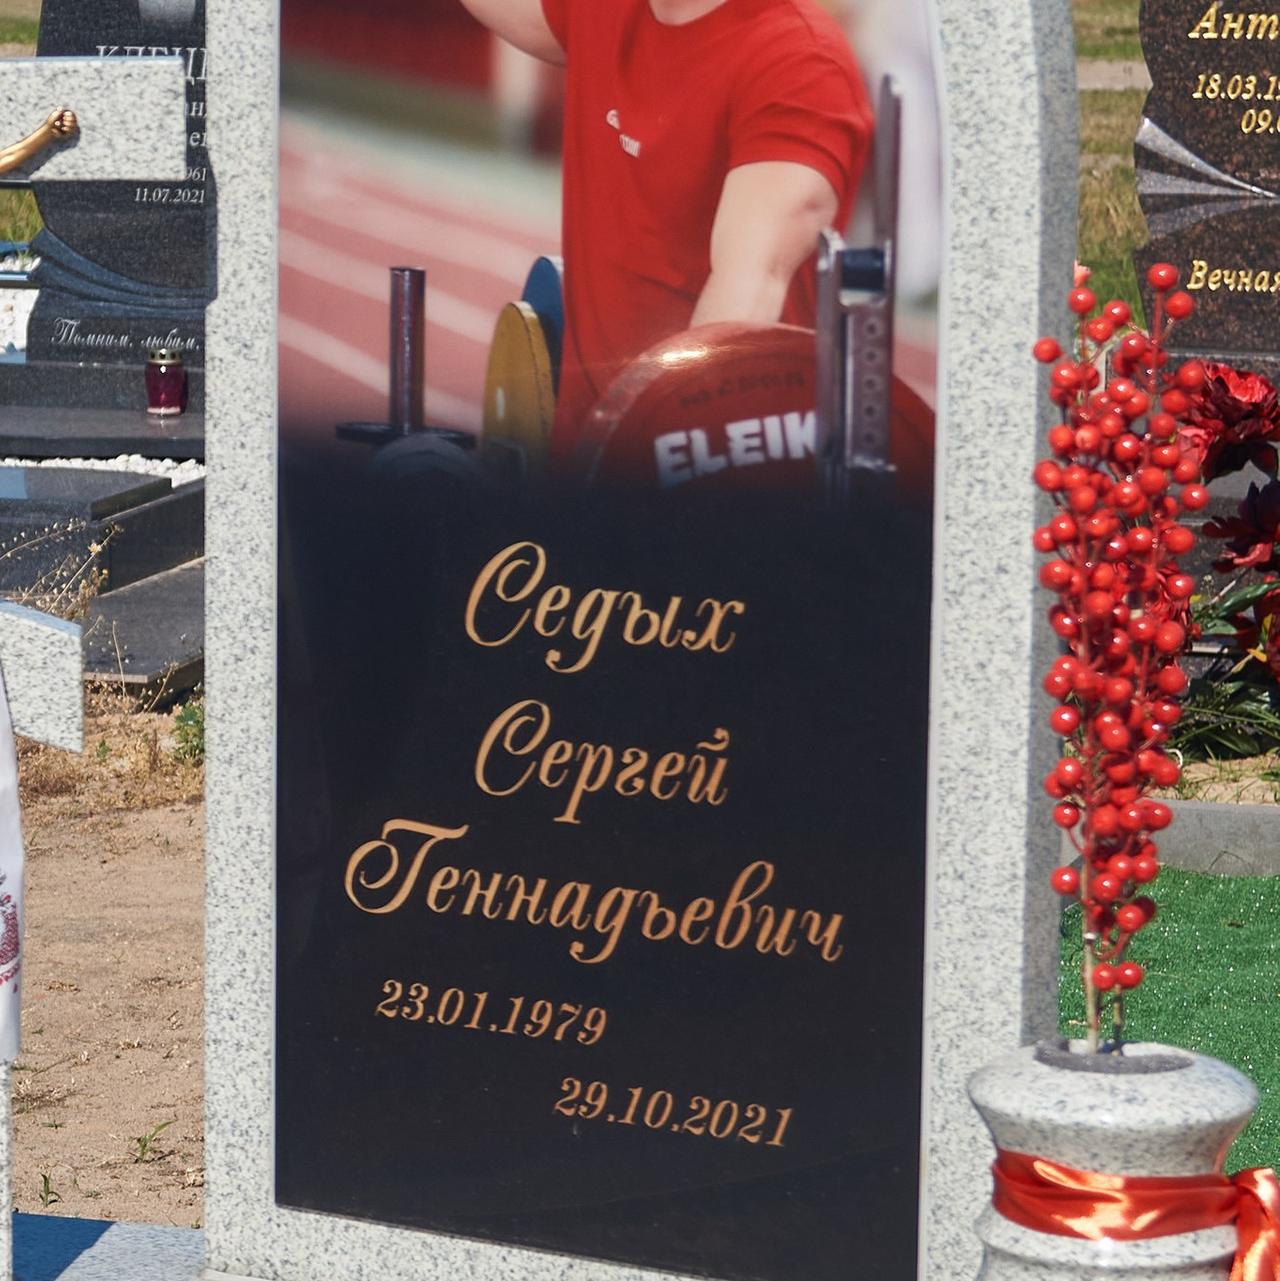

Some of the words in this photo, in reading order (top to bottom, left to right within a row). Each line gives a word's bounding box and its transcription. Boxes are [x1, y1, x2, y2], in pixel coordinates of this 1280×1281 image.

[1187, 0, 1280, 41] Ант
[134, 187, 206, 204] 11.07.2021
[464, 541, 746, 674] Седых
[474, 699, 731, 825] Сергей
[343, 817, 845, 965] Геннадьевич
[374, 979, 608, 1046] 23.01.1979
[551, 1076, 794, 1148] 29.10.2021
